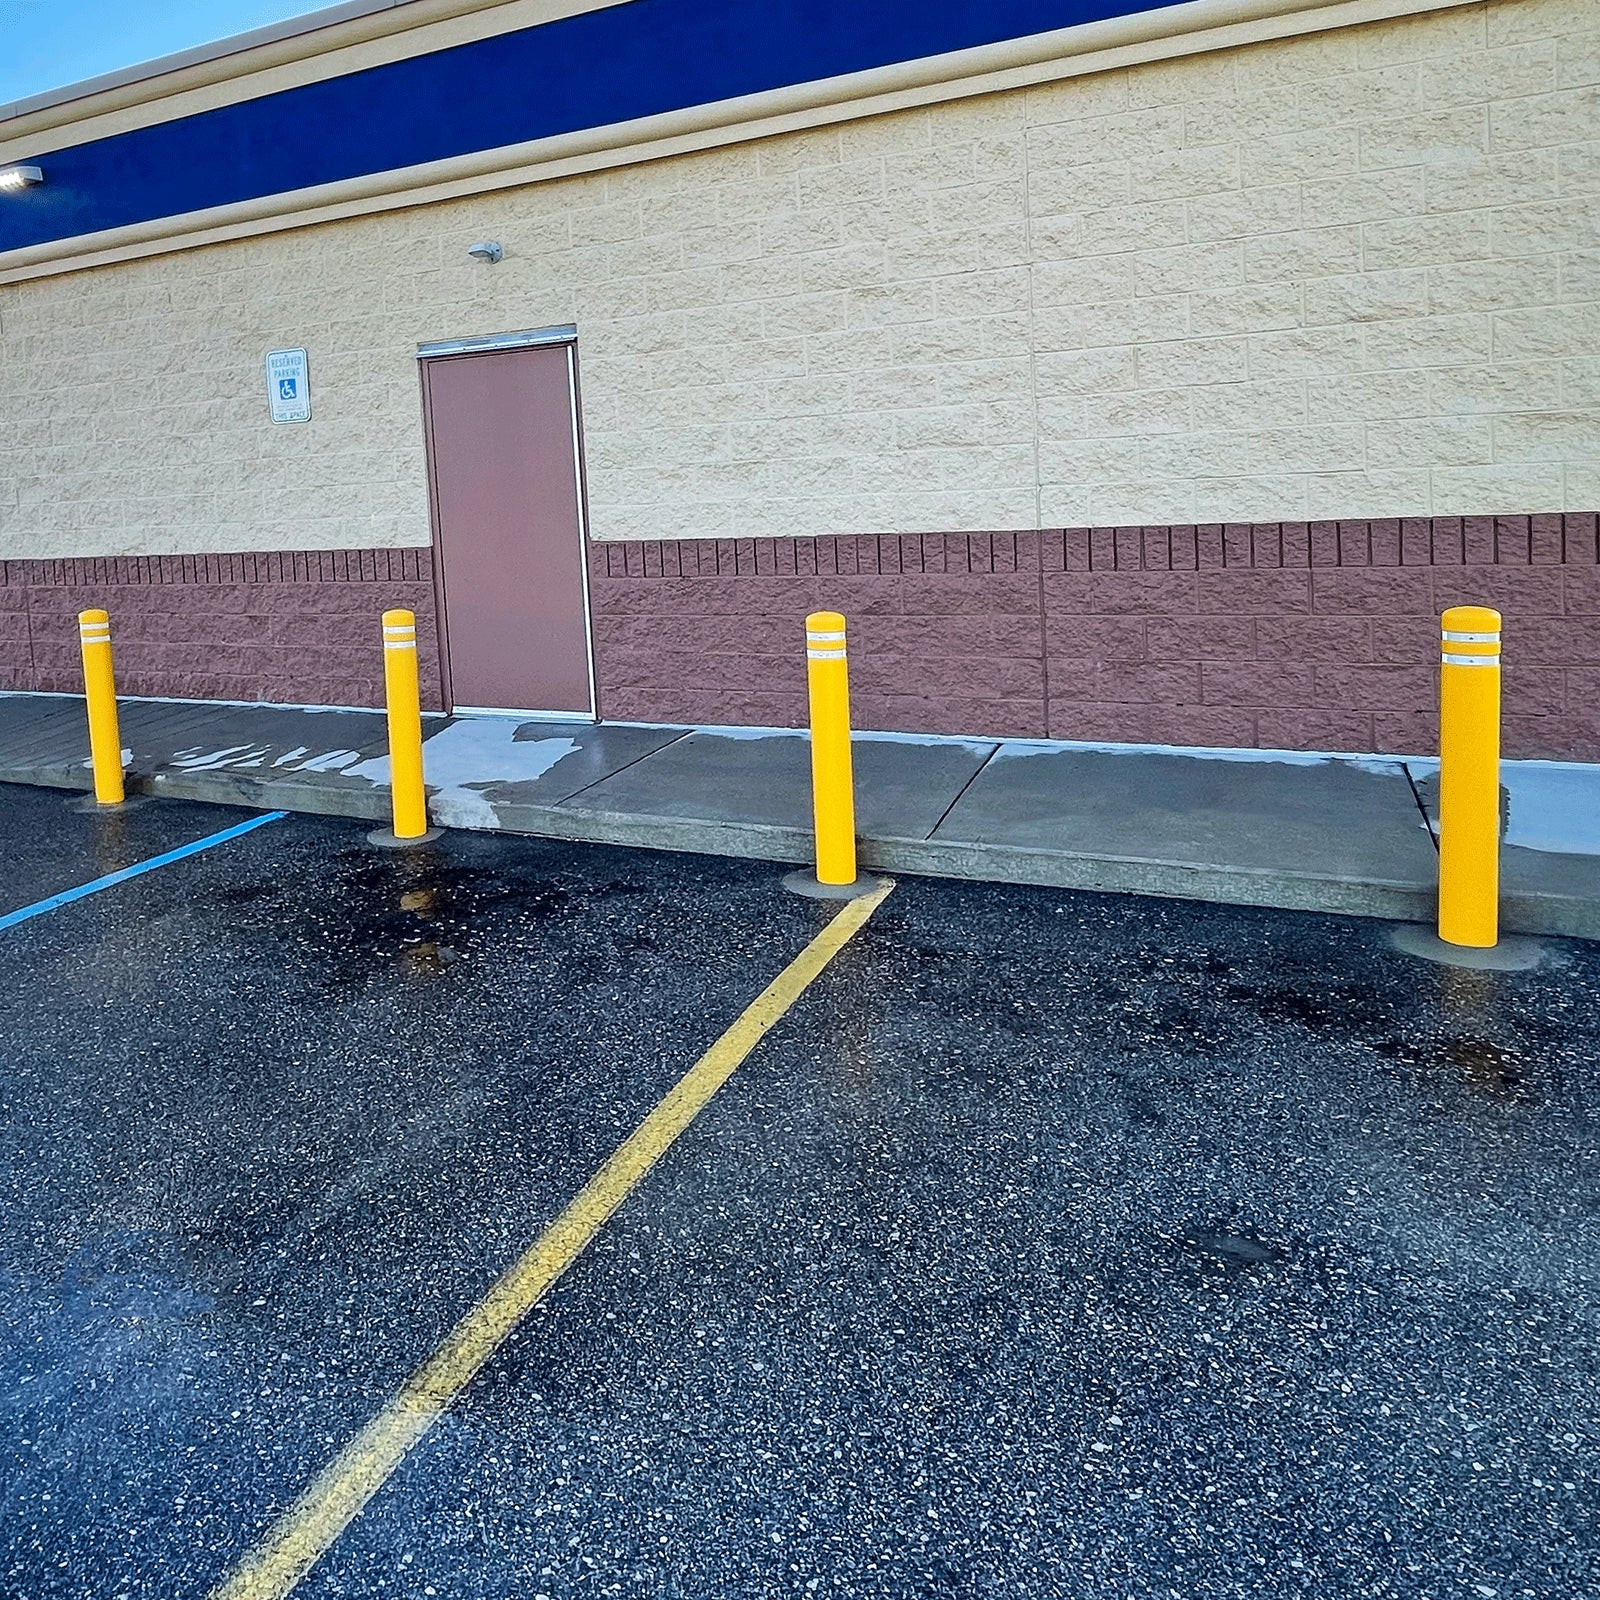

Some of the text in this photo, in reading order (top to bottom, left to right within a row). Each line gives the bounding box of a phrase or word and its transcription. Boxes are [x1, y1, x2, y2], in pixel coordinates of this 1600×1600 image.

[271, 356, 302, 368] RESERVED
[274, 367, 300, 378] PARKING
[290, 410, 306, 418] SPACE
